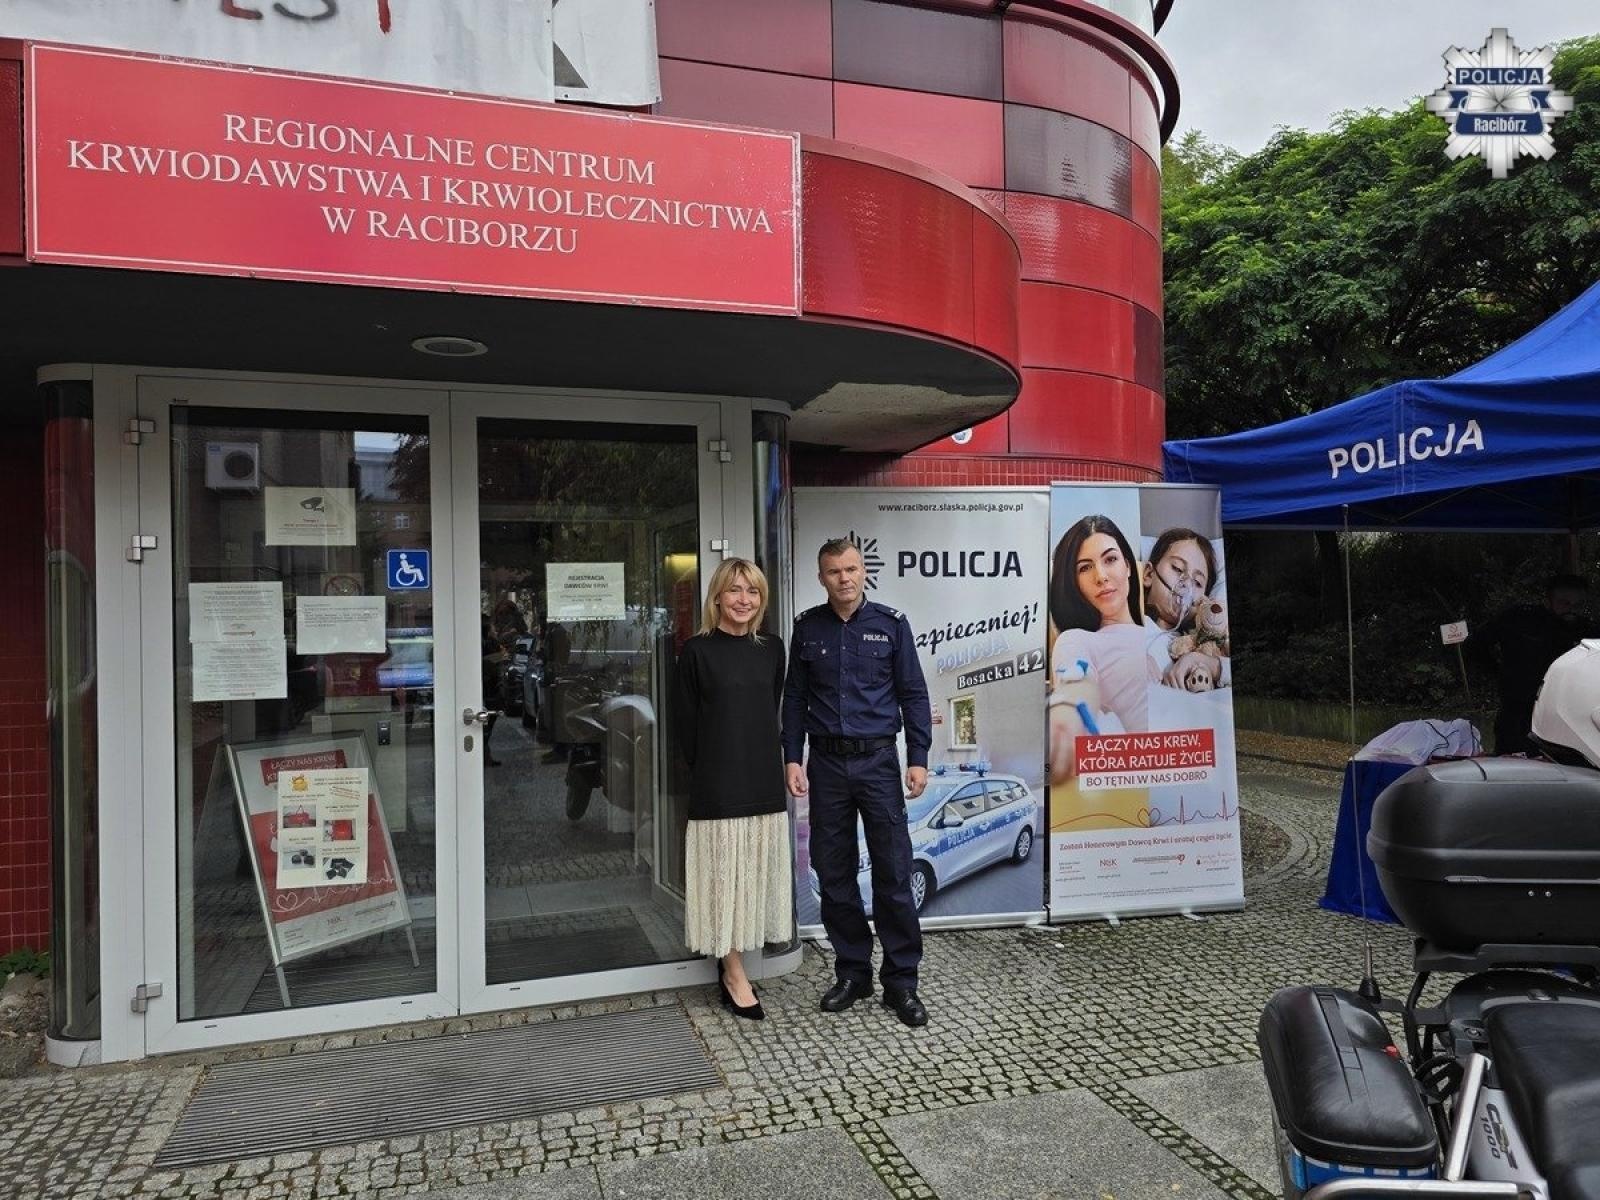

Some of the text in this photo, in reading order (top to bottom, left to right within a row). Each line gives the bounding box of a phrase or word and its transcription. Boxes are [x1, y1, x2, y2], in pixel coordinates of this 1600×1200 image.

[223, 113, 656, 187] REGIONALNE CENTRUM
[66, 138, 774, 234] KRWIODAWSTWA I KRWIOLECZNICTWA
[320, 206, 579, 254] W RACIBORZU
[1328, 419, 1485, 480] POLICJA
[878, 503, 1024, 513] www.raciborz.slaska.policja.gov.pl
[898, 551, 1024, 578] POLICJA
[863, 633, 889, 643] POLICJA
[958, 650, 1044, 690] Bosacka 42
[1079, 750, 1213, 771] KTÓRA RATUJE ŻYCIE
[1086, 733, 1201, 757] ŁĄCZY NAS KREW,
[1086, 770, 1208, 787] BO TĘTNI W NAS DOBRO
[1480, 1116, 1501, 1159] 1000
